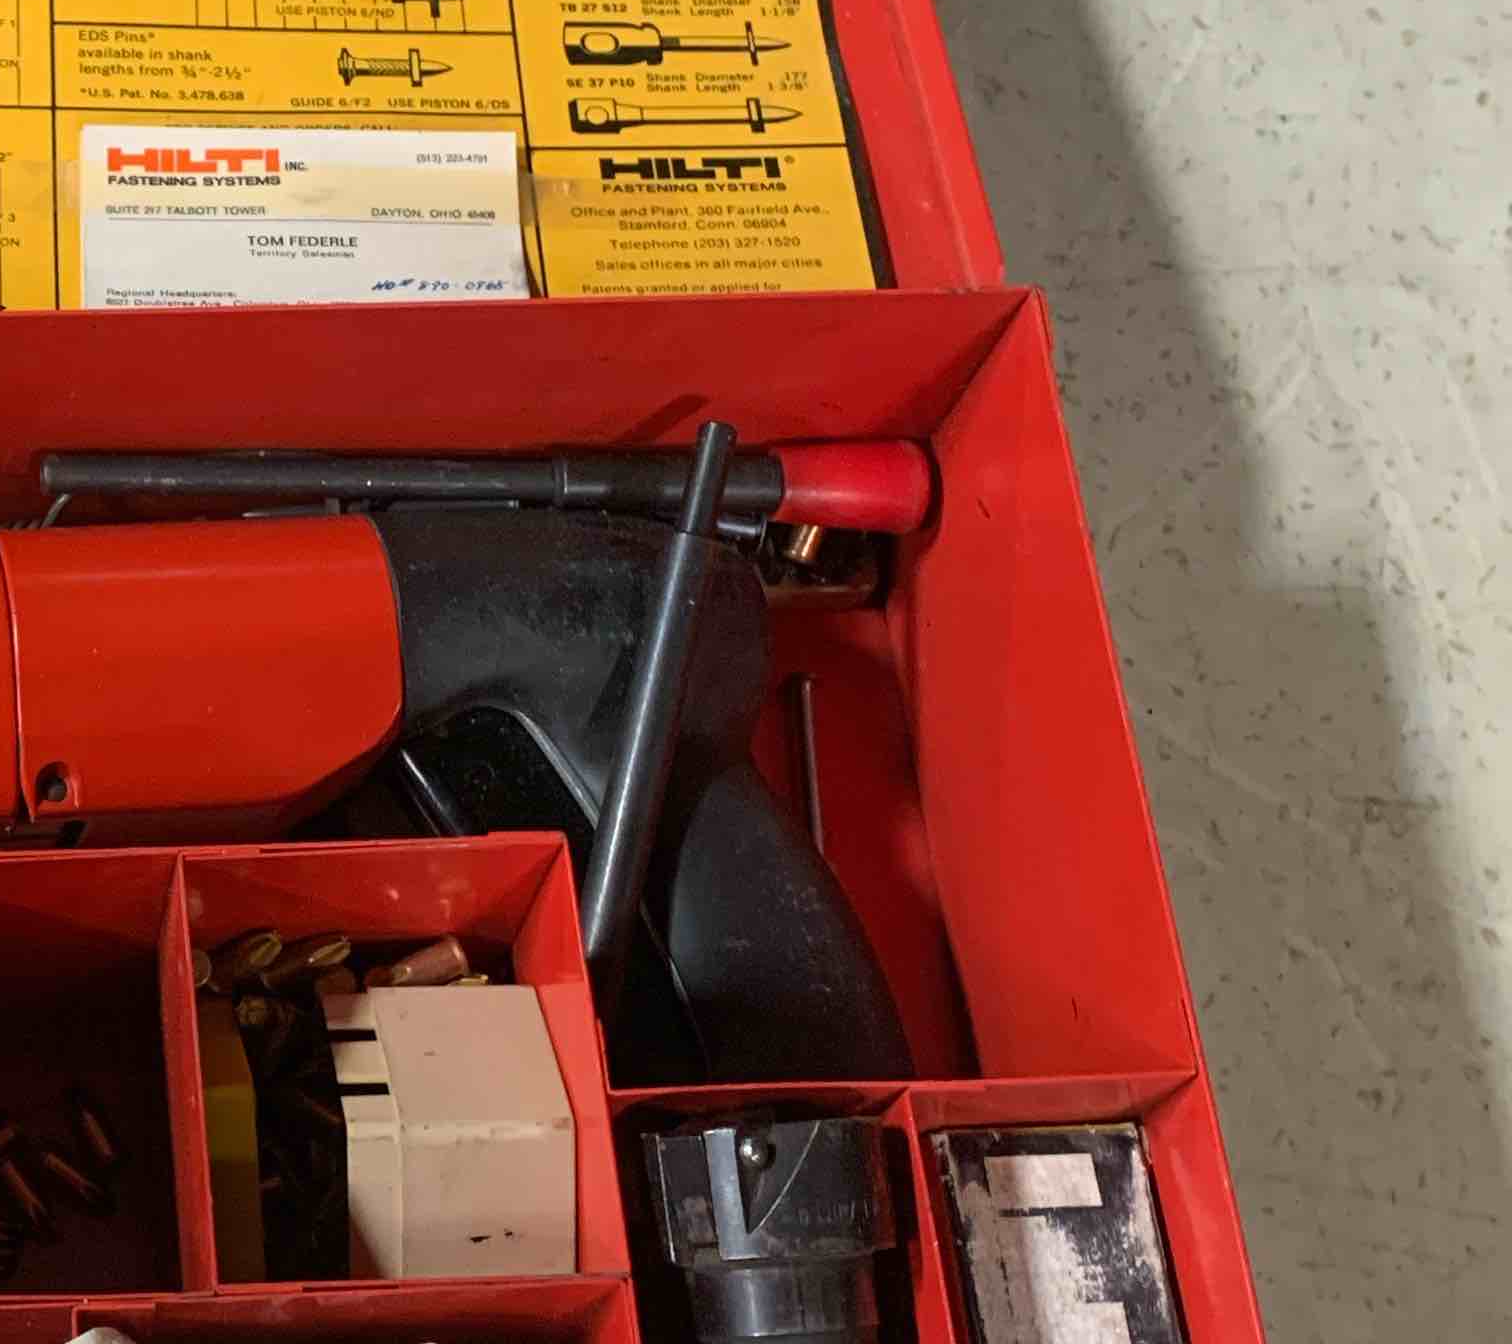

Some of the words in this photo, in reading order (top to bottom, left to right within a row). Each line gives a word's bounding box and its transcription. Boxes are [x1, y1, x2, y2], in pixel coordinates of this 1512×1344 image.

[78, 30, 110, 42] EDS
[78, 47, 145, 61] available
[149, 49, 163, 61] in
[167, 49, 212, 62] shank
[107, 148, 280, 173] HILTI
[600, 157, 781, 179] HILTI
[108, 175, 197, 187] FASTENING
[203, 176, 281, 186] SYSTEMS
[602, 183, 698, 193] FASTENING
[705, 182, 787, 193] SYSTEMS
[106, 205, 139, 215] SUITE
[223, 206, 266, 215] TOWER
[248, 235, 285, 247] TOM
[289, 236, 357, 248] FEDERLE
[609, 238, 688, 250] Telephone
[596, 259, 636, 271] Sales
[640, 258, 692, 270] offices
[696, 259, 707, 269] in
[713, 258, 730, 268] all
[735, 259, 777, 272] major
[782, 258, 822, 268] cities
